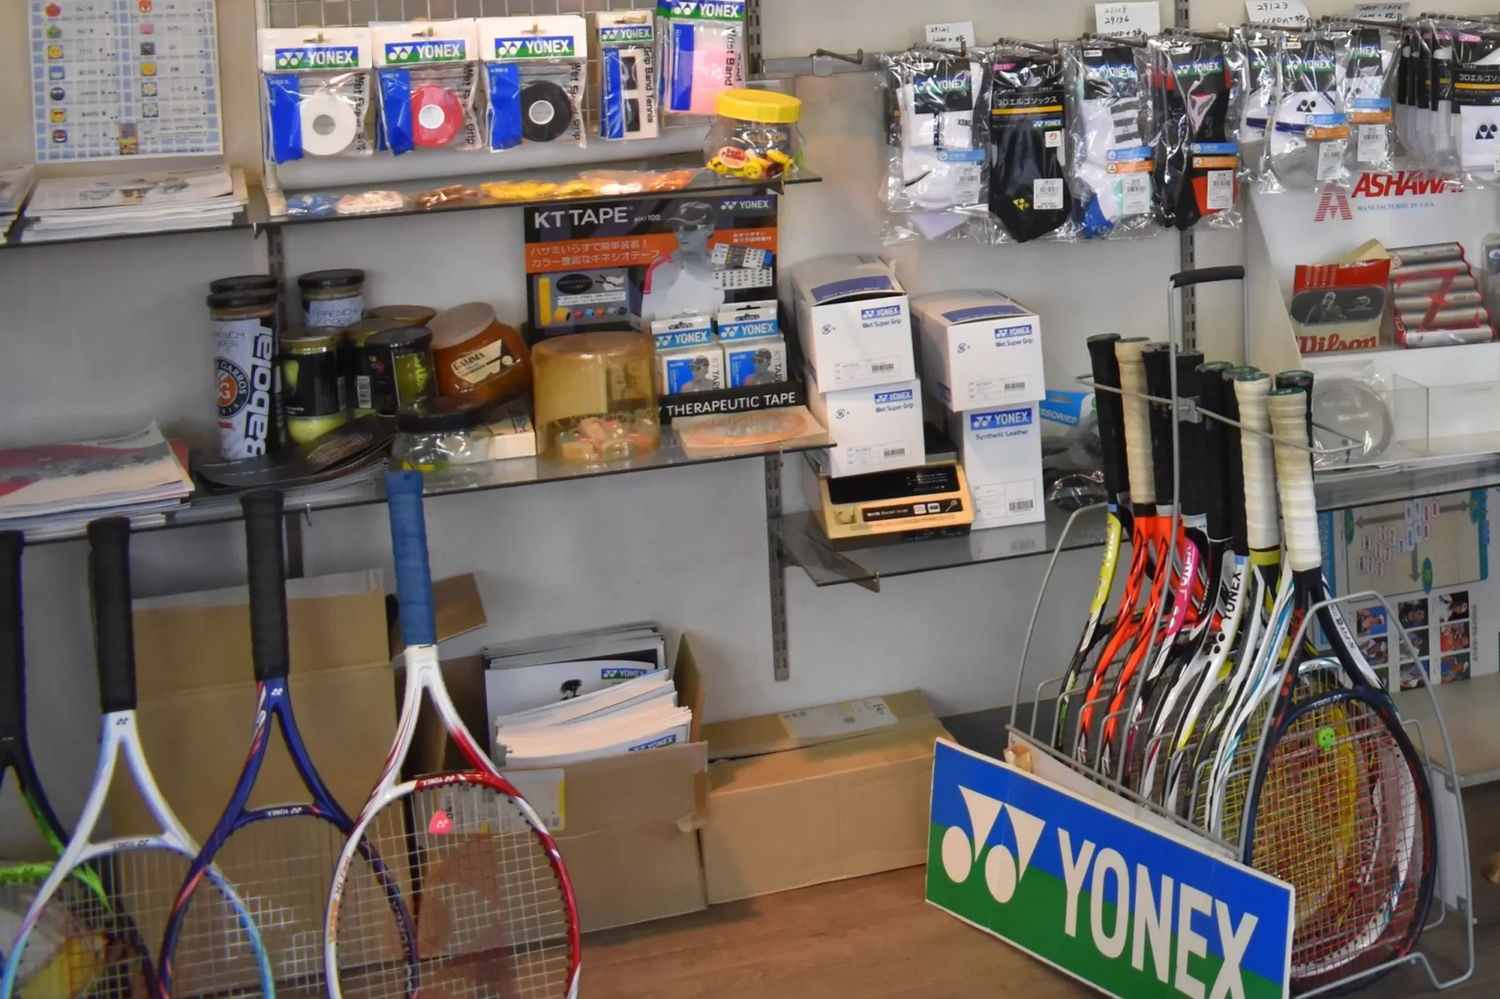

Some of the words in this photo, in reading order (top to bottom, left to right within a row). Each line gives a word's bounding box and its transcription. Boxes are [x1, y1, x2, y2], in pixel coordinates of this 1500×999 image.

[698, 2, 740, 18] YONEX
[620, 29, 650, 38] YONEX
[416, 43, 461, 59] YONEX
[526, 40, 570, 55] YONEX
[308, 51, 353, 65] YONEX
[1193, 61, 1219, 72] YONEX
[1303, 60, 1331, 69] YONEX
[645, 67, 653, 90] Band
[937, 80, 966, 88] YONEX
[646, 93, 654, 123] Tennis
[739, 200, 769, 209] YONEX
[534, 211, 565, 229] KT
[569, 206, 628, 226] TAPE
[877, 308, 898, 316] YONEX
[741, 323, 774, 335] YONEX
[1009, 327, 1030, 335] YONEX
[675, 332, 707, 344] YONEX
[244, 325, 273, 458] Babolat
[666, 397, 759, 416] THERAPEUTIC
[763, 392, 796, 405] TAPE
[994, 411, 1029, 424] YONEX
[976, 432, 1004, 440] Synthetic
[1222, 571, 1242, 621] YONEX
[422, 777, 447, 786] YONEX
[267, 807, 290, 818] YONEX
[1057, 827, 1260, 999] YONEX
